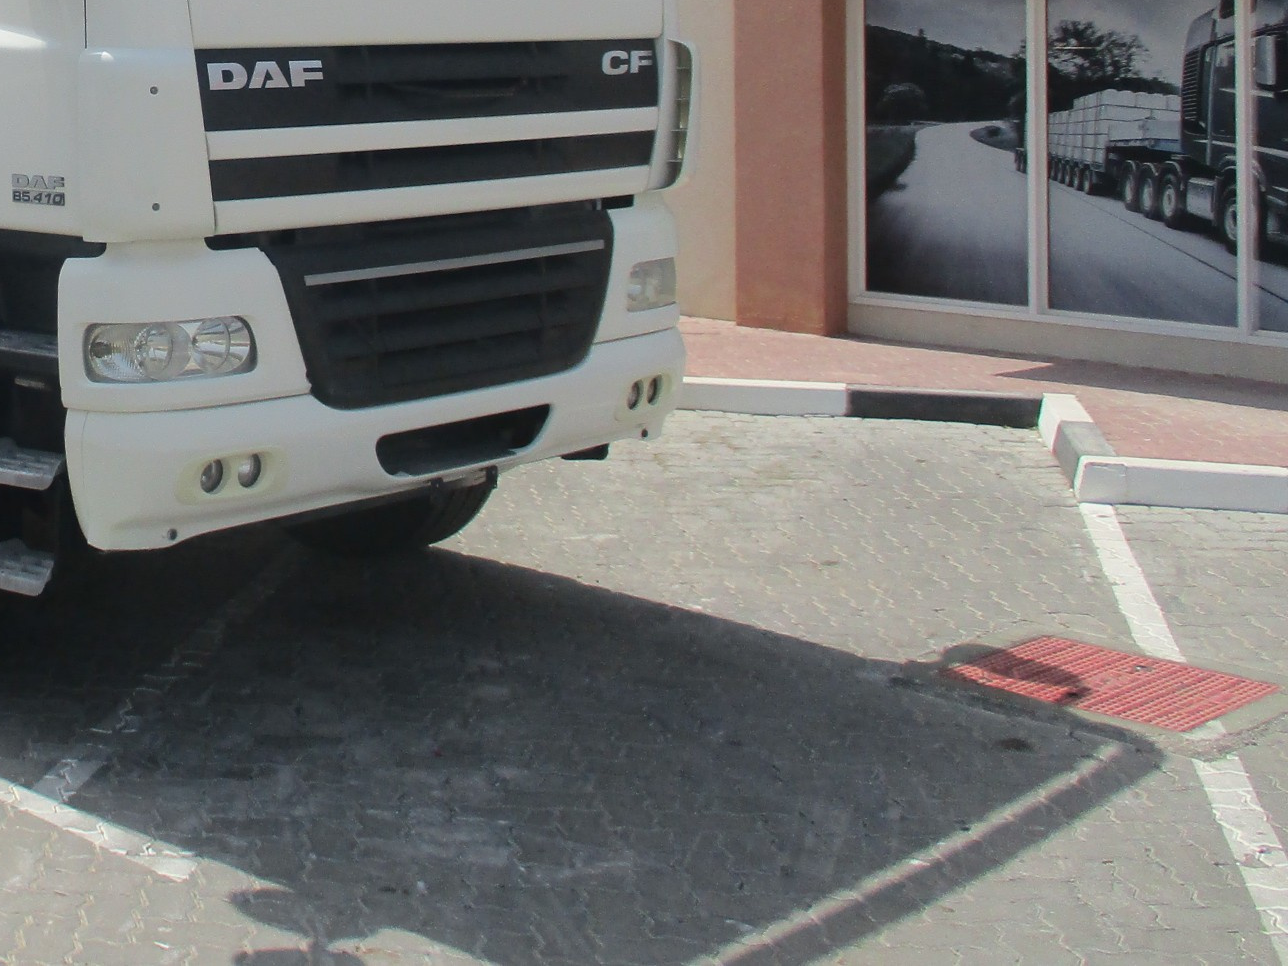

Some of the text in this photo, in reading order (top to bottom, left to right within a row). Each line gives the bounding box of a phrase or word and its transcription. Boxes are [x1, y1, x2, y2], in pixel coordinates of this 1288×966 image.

[602, 50, 653, 76] CF
[206, 59, 323, 91] DAF
[11, 173, 65, 189] DAF
[13, 190, 65, 206] 85.410
